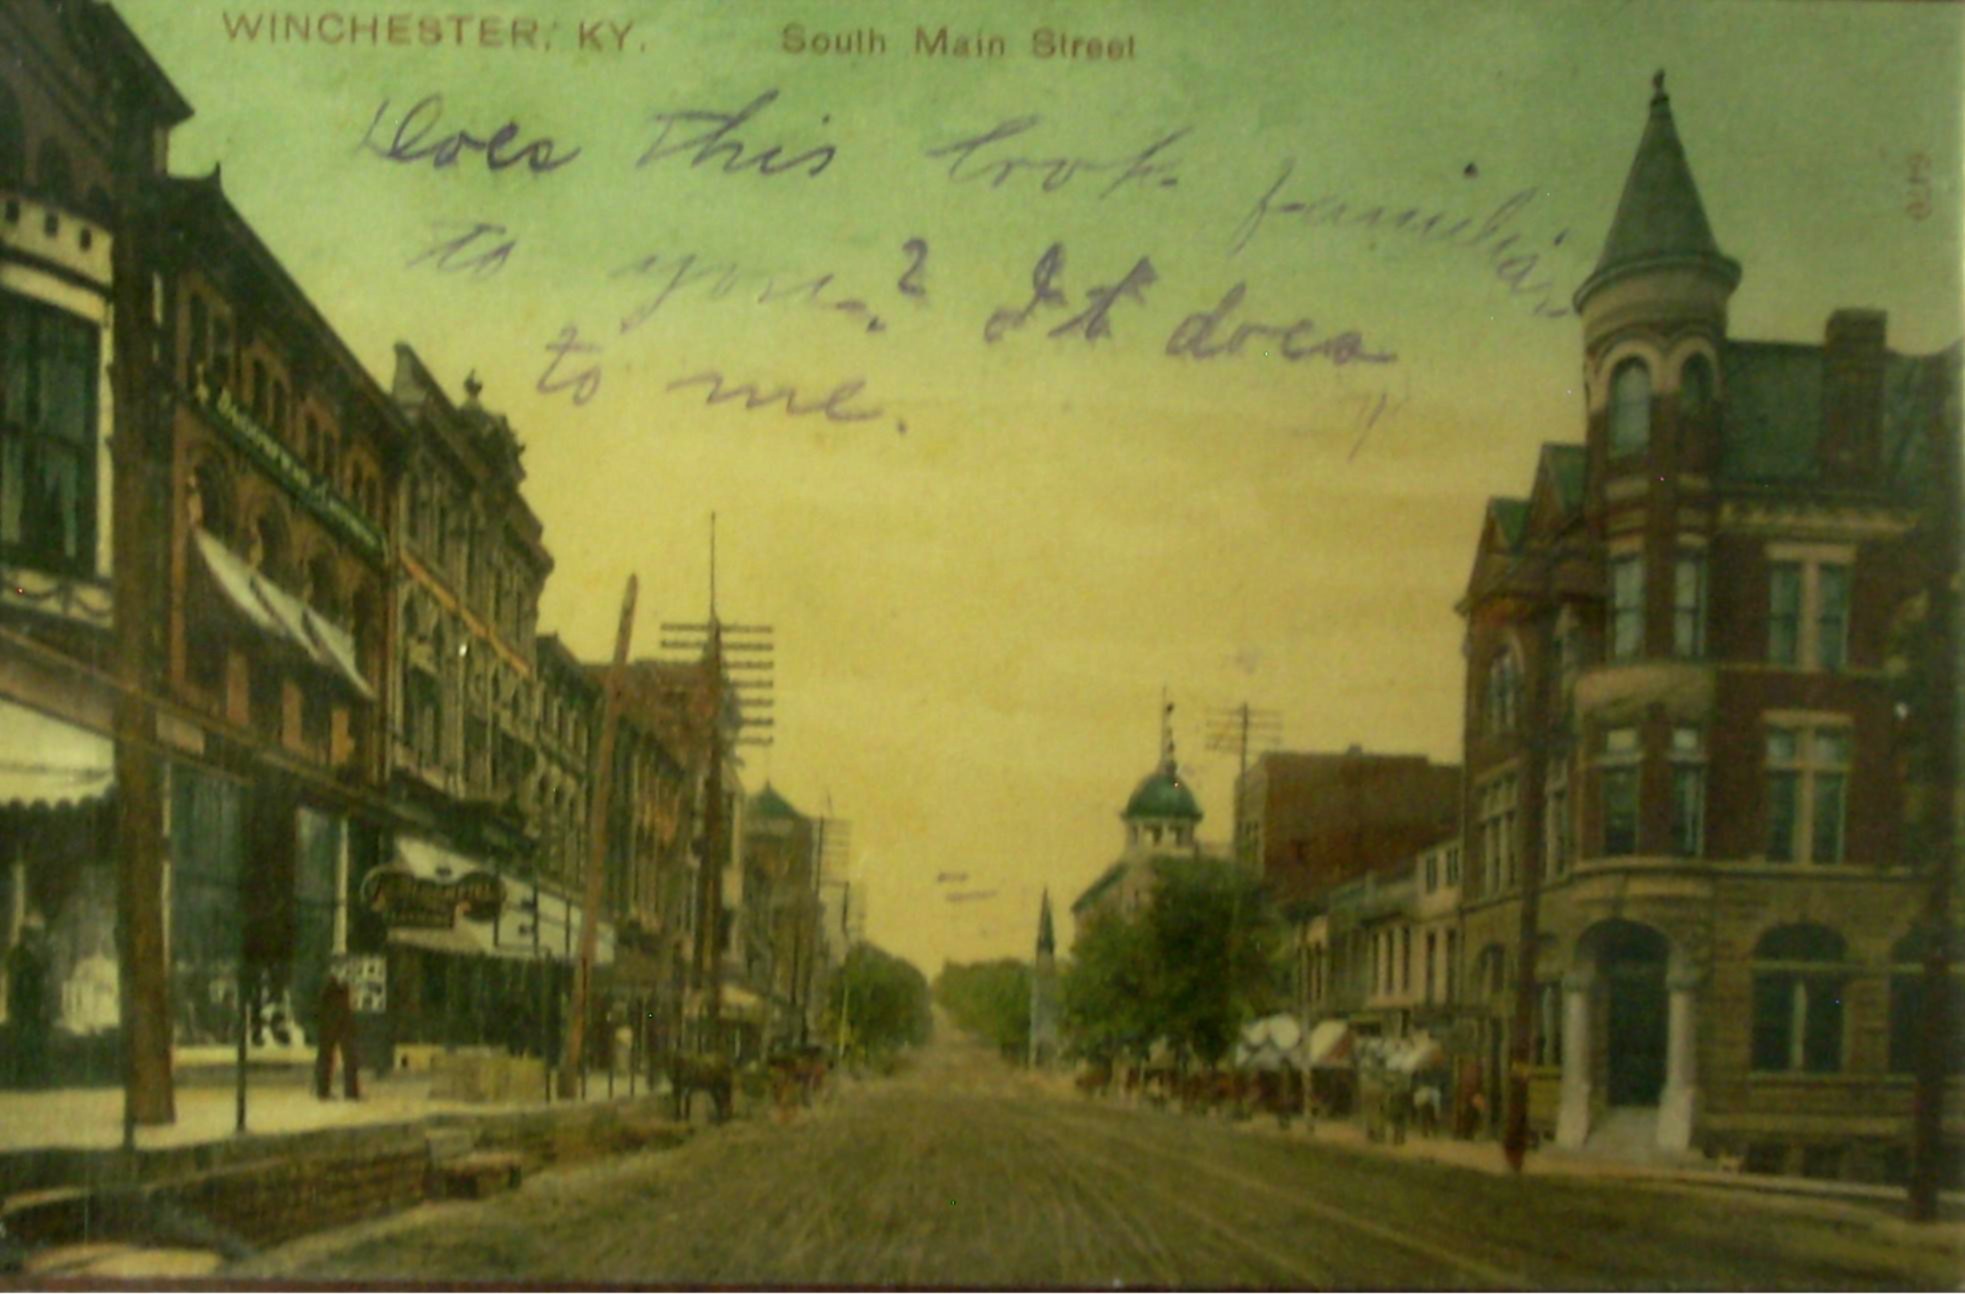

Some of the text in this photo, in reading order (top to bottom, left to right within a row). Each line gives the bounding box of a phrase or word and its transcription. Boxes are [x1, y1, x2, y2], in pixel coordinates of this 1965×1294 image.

[360, 94, 581, 172] Does
[404, 220, 518, 276] to
[534, 325, 608, 406] to
